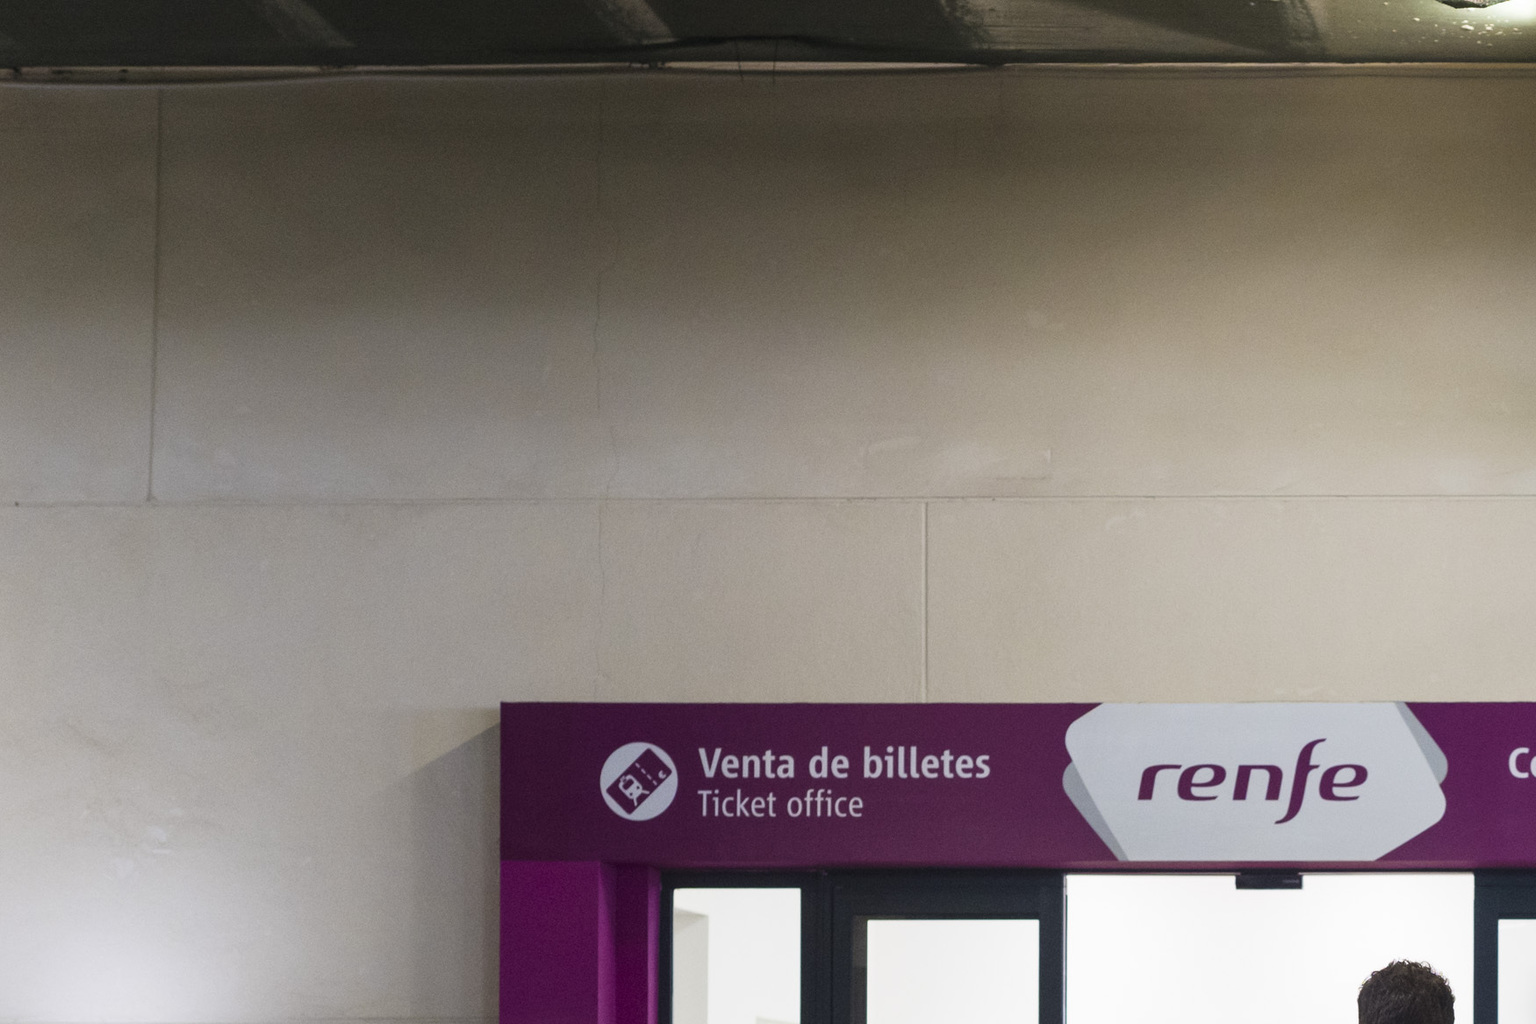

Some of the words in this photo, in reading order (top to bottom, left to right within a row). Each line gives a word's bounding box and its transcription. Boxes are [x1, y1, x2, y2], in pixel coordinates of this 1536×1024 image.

[698, 747, 795, 779] Venta
[808, 746, 850, 779] de
[863, 746, 991, 779] billetes
[1137, 738, 1368, 825] renfe
[698, 789, 777, 818] Ticket
[787, 788, 864, 818] office
